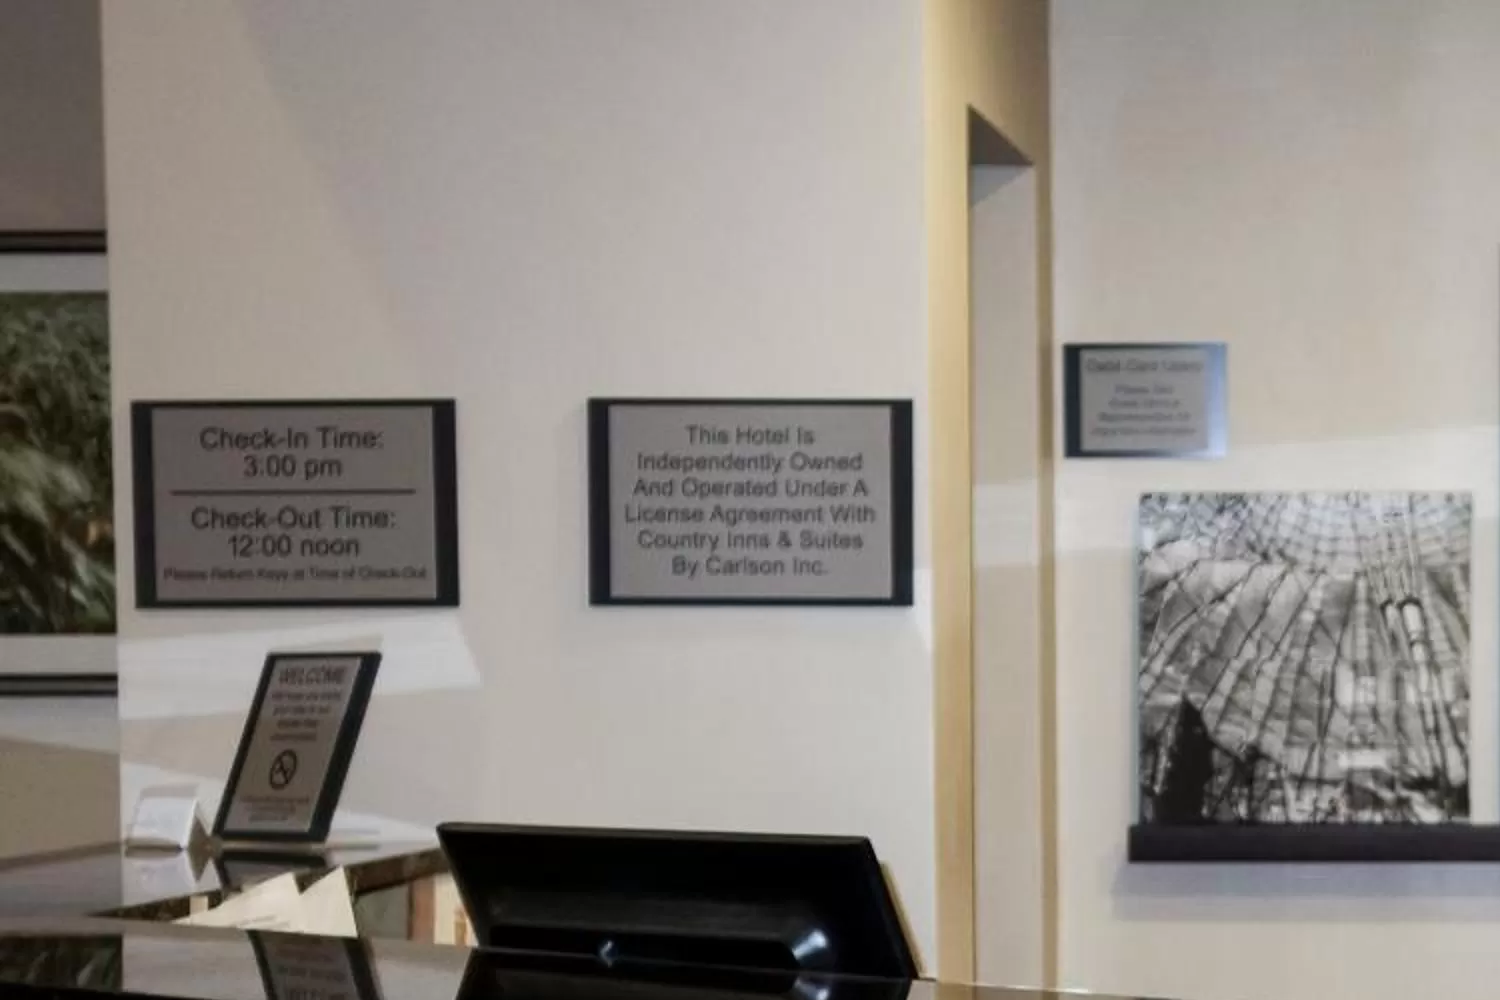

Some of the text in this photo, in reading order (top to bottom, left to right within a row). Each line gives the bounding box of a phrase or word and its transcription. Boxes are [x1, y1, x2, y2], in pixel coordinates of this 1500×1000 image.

[198, 425, 385, 451] Check-In Time:
[685, 425, 816, 447] This Hotel Is
[243, 455, 343, 481] 3:00 pm
[635, 452, 864, 475] Independently Owned
[631, 477, 869, 501] And Operated Under A
[190, 505, 396, 530] Check-Out Time:
[623, 504, 876, 528] License Agreement With
[228, 535, 360, 558] 12:00 noon
[636, 530, 864, 553] Country Inns & Suites
[671, 555, 830, 579] By Carlson Inc.
[277, 665, 347, 686] WELCOME
